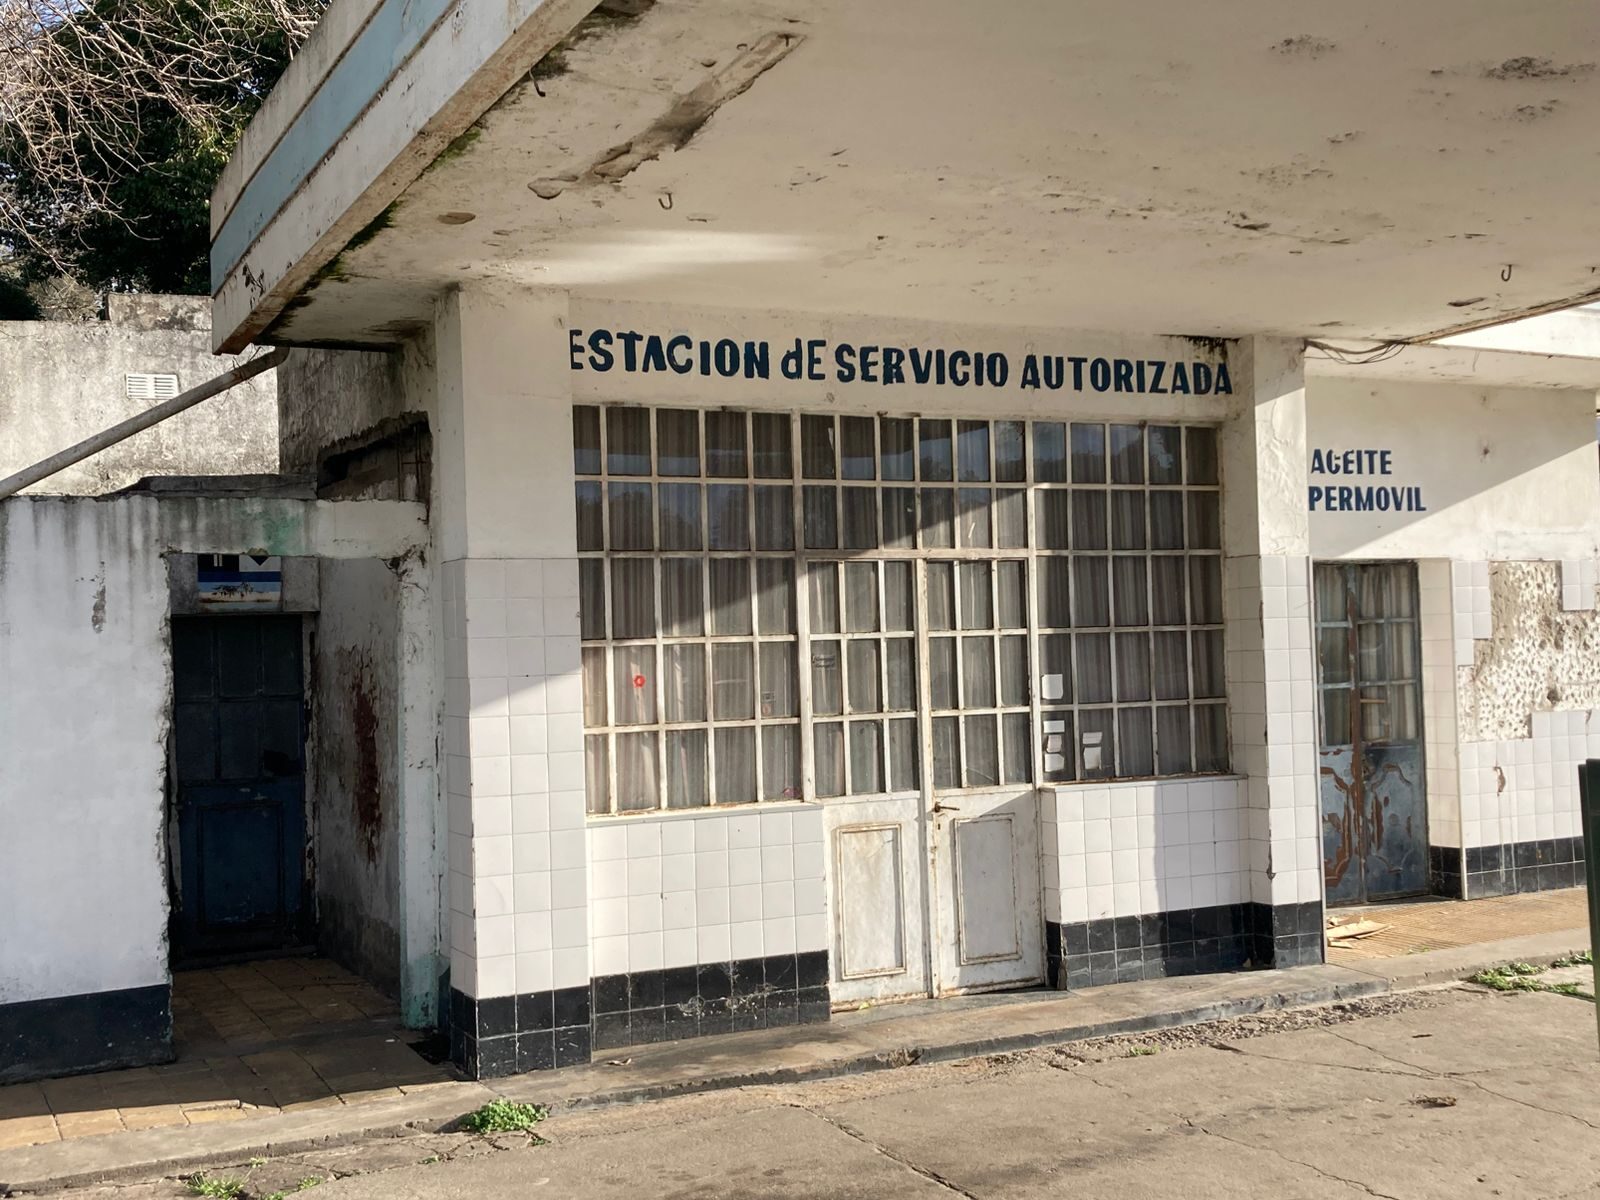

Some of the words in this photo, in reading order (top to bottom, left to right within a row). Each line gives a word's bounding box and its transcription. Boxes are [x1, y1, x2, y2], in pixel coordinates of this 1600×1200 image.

[569, 328, 770, 380] ESTACION
[834, 343, 1009, 387] SERVICIO
[1020, 353, 1233, 395] AUTORIZADA
[1310, 448, 1392, 475] ACEITE
[1308, 486, 1427, 512] PERMOVIL
